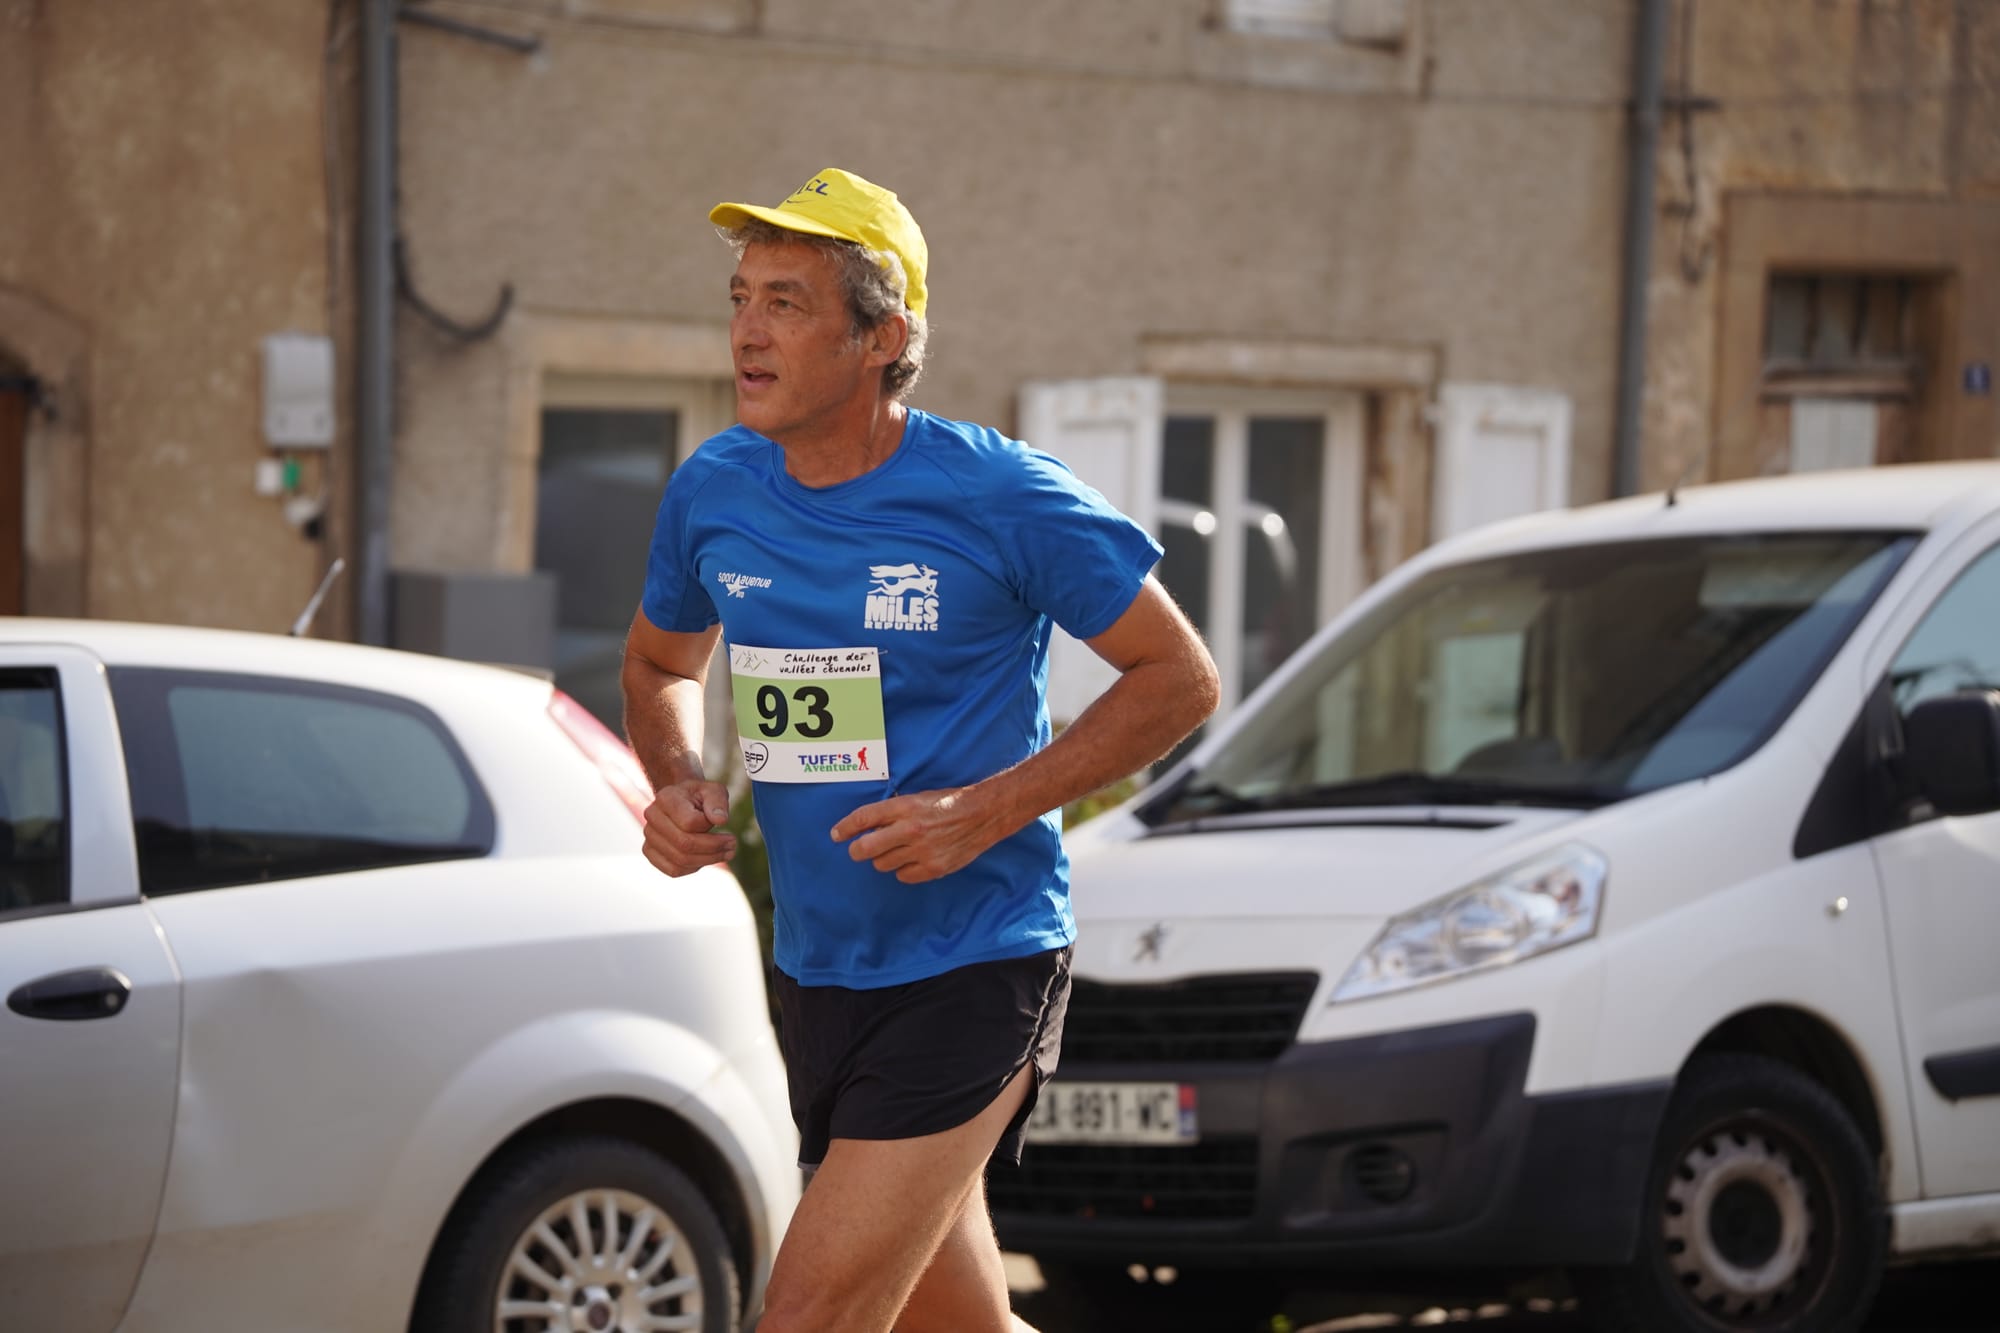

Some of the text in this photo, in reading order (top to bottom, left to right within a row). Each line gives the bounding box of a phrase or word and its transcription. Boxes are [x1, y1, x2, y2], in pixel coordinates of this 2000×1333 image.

[863, 620, 938, 632] REPUBLIC
[784, 651, 865, 666] Challenge des
[779, 663, 815, 674] vallées
[756, 684, 834, 738] 93
[797, 753, 852, 765] TUFF'S
[804, 762, 858, 773] Aventure
